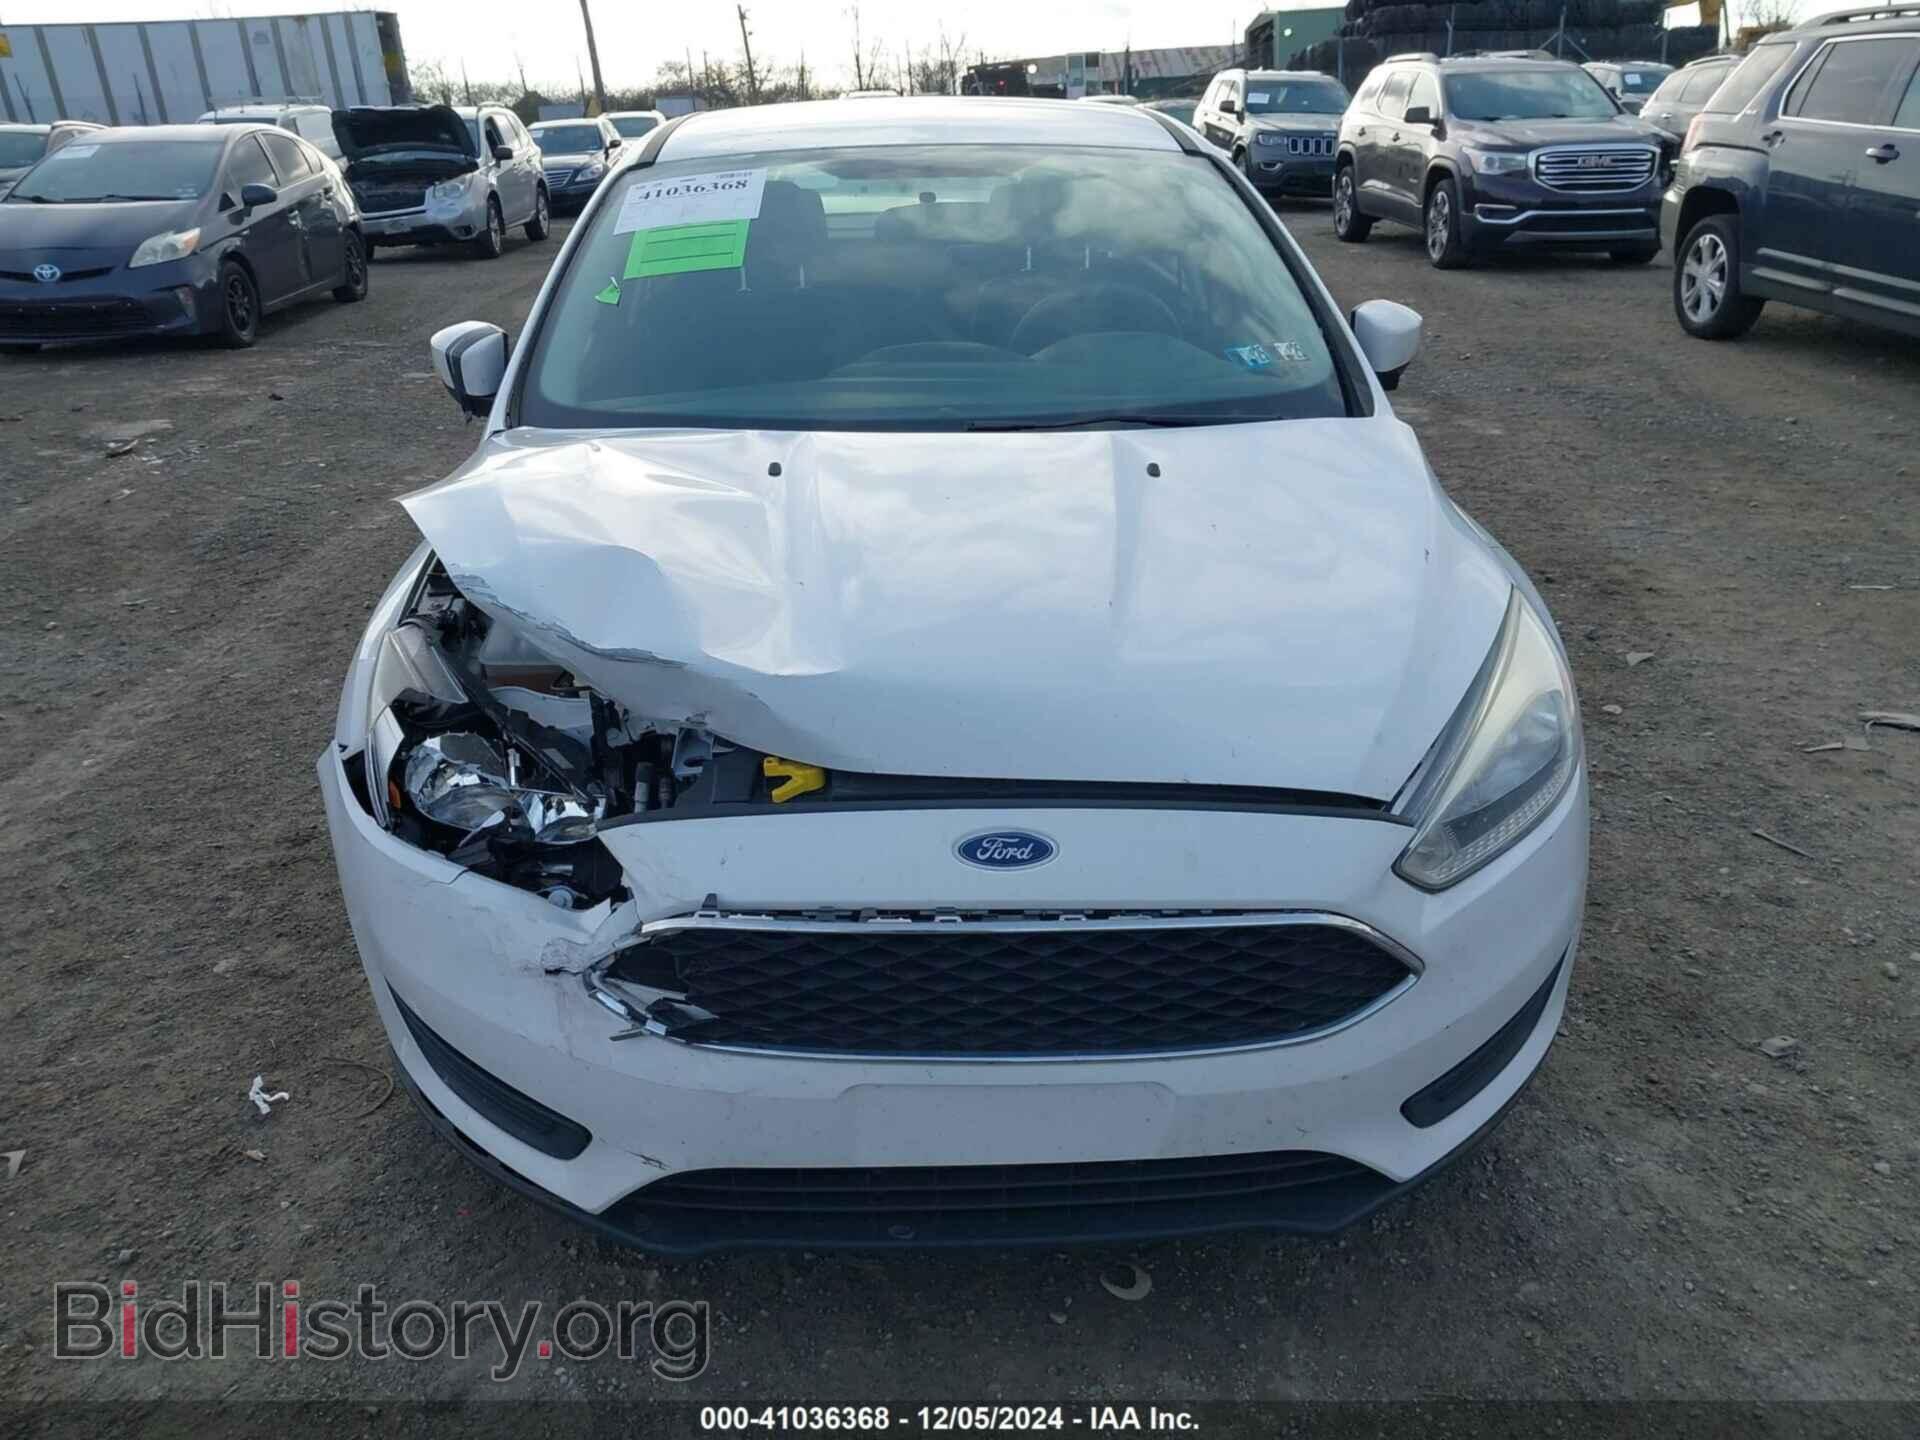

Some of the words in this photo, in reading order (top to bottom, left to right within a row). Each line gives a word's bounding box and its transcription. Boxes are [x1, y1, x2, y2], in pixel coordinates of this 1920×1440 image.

[1577, 155, 1620, 169] GMC
[639, 179, 749, 200] 41036368
[976, 837, 1034, 860] Ford
